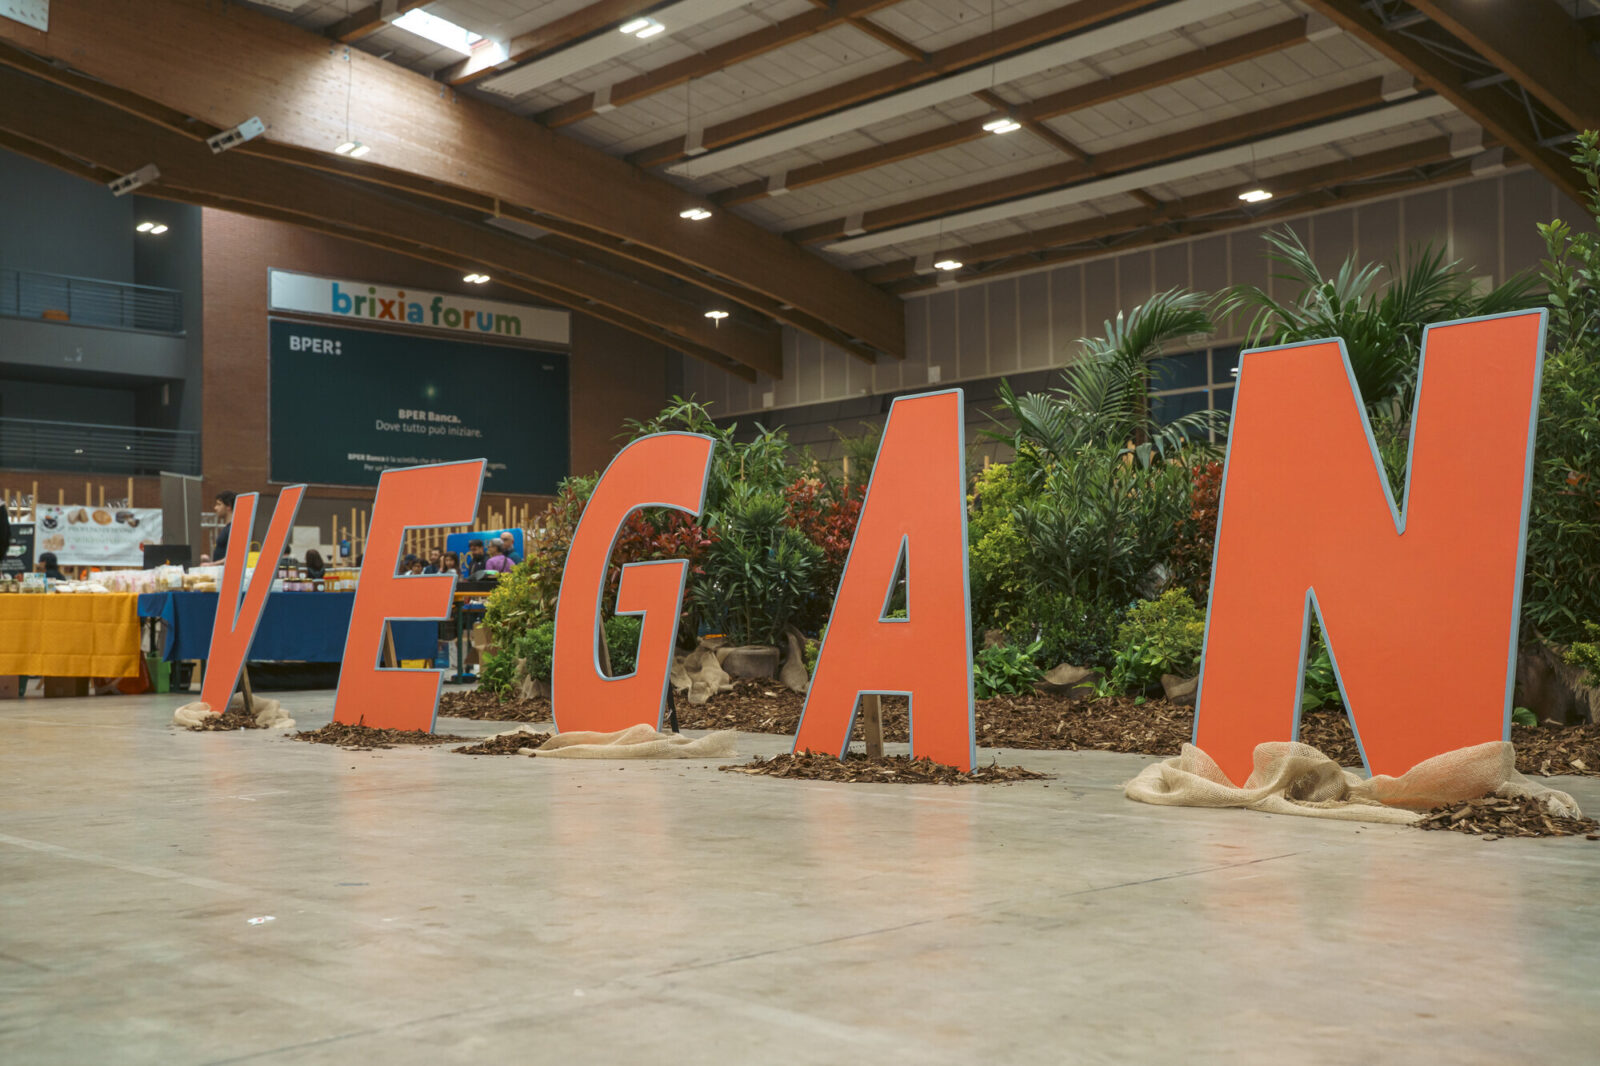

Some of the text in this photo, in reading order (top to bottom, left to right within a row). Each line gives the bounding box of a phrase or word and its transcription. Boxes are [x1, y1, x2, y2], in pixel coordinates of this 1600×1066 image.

[332, 282, 521, 336] brixia forum
[398, 408, 461, 423] BPER Banca.
[375, 419, 483, 438] Dove tutto può iniziare.
[347, 452, 365, 461] BPER
[200, 307, 1549, 790] VEGAN
